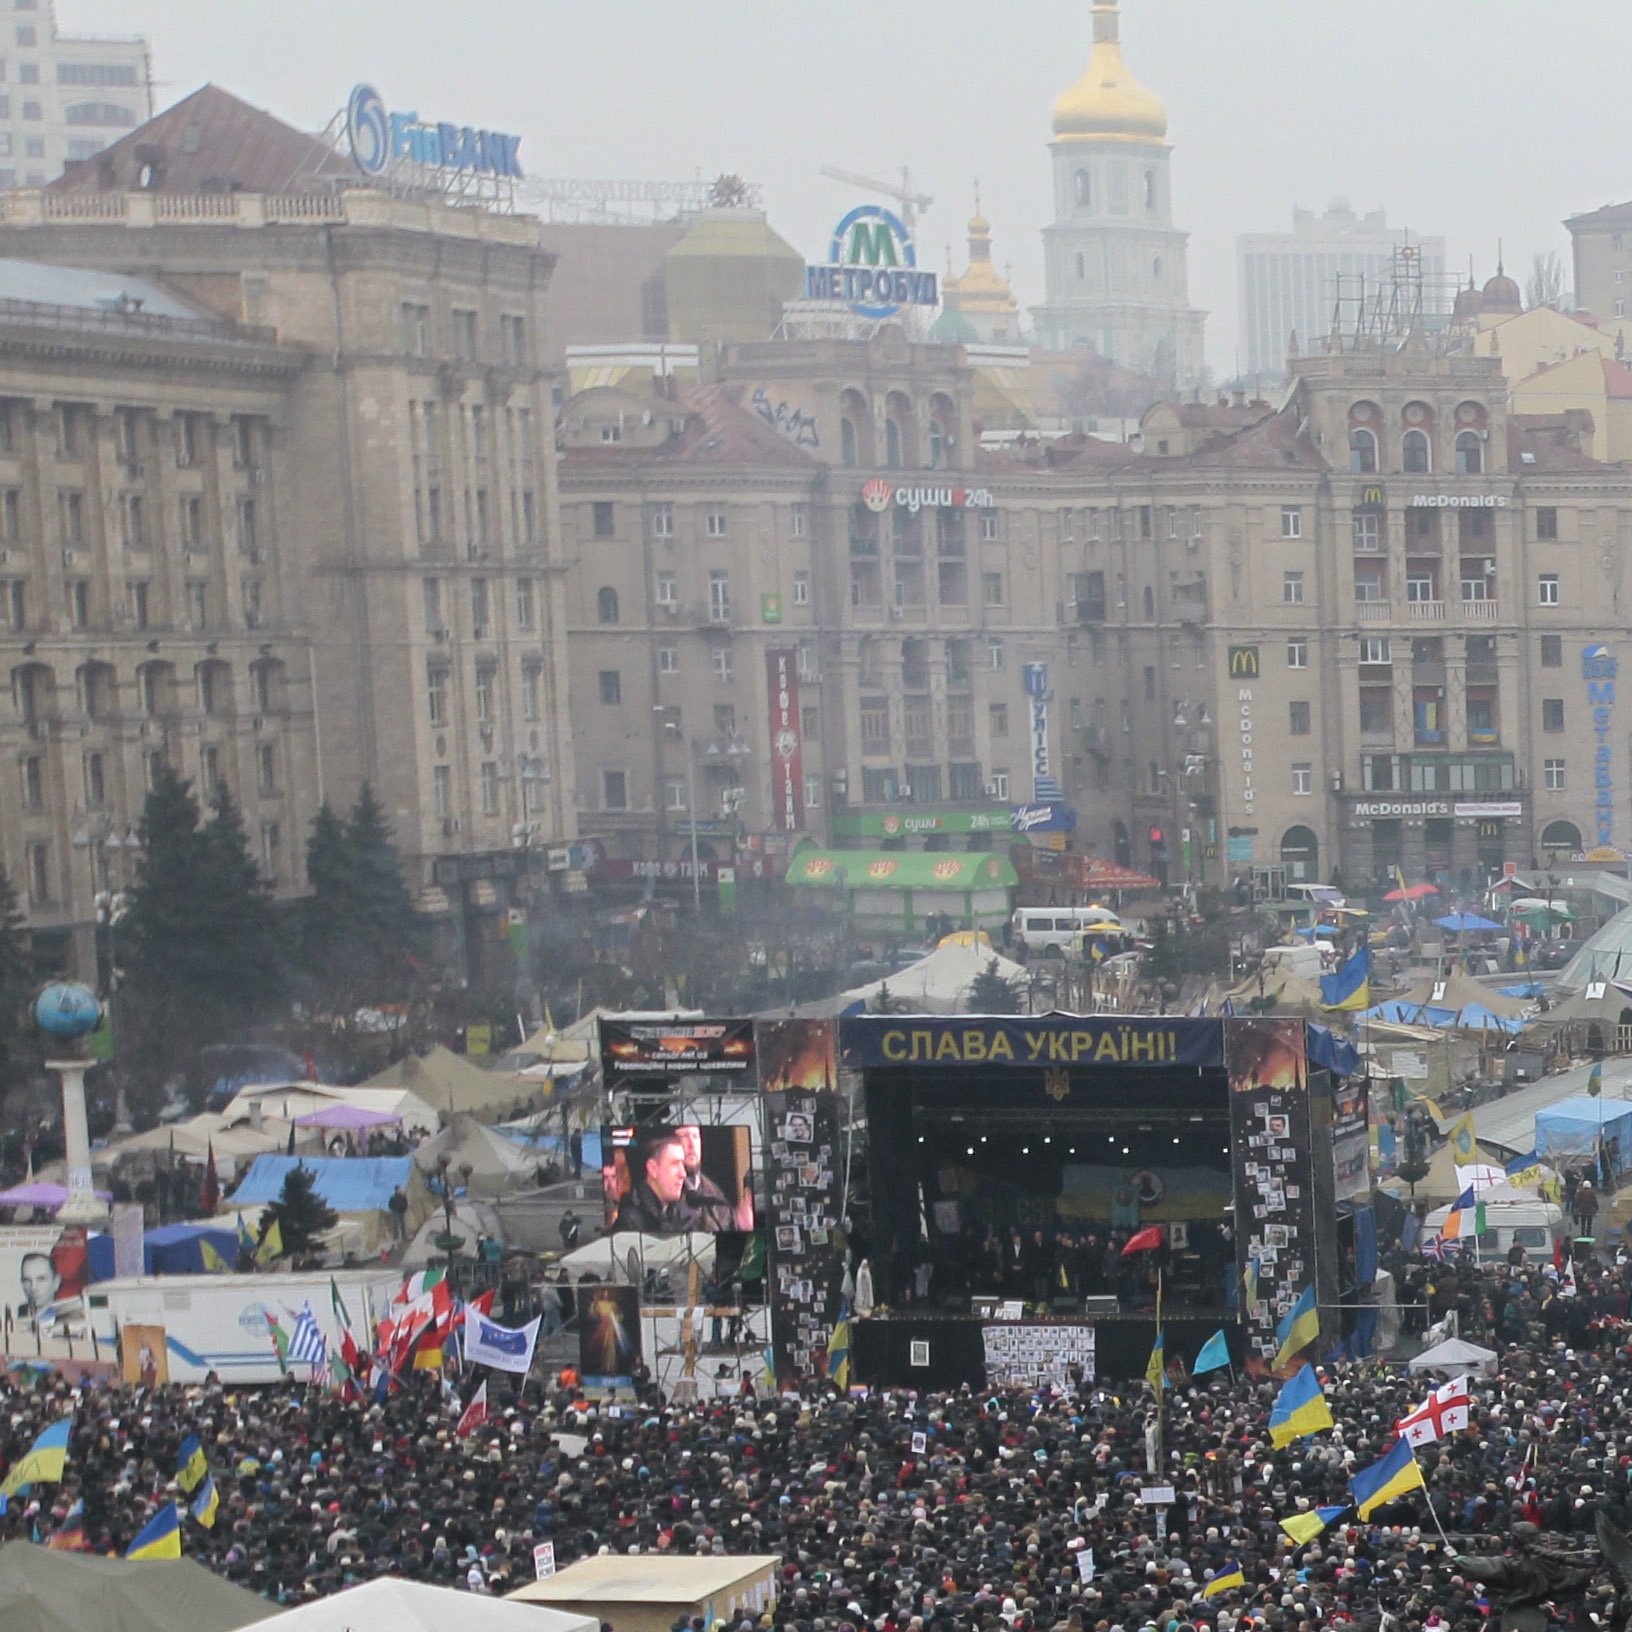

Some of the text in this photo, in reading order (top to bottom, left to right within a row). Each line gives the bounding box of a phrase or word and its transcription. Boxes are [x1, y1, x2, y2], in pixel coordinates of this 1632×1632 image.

[391, 111, 524, 178] FinBANK
[806, 266, 938, 305] МЕТРОБУД
[1413, 495, 1506, 507] McDonald's
[1355, 802, 1448, 815] McDonald's
[883, 1026, 1176, 1061] СЛАВА УКРАЇНІ!
